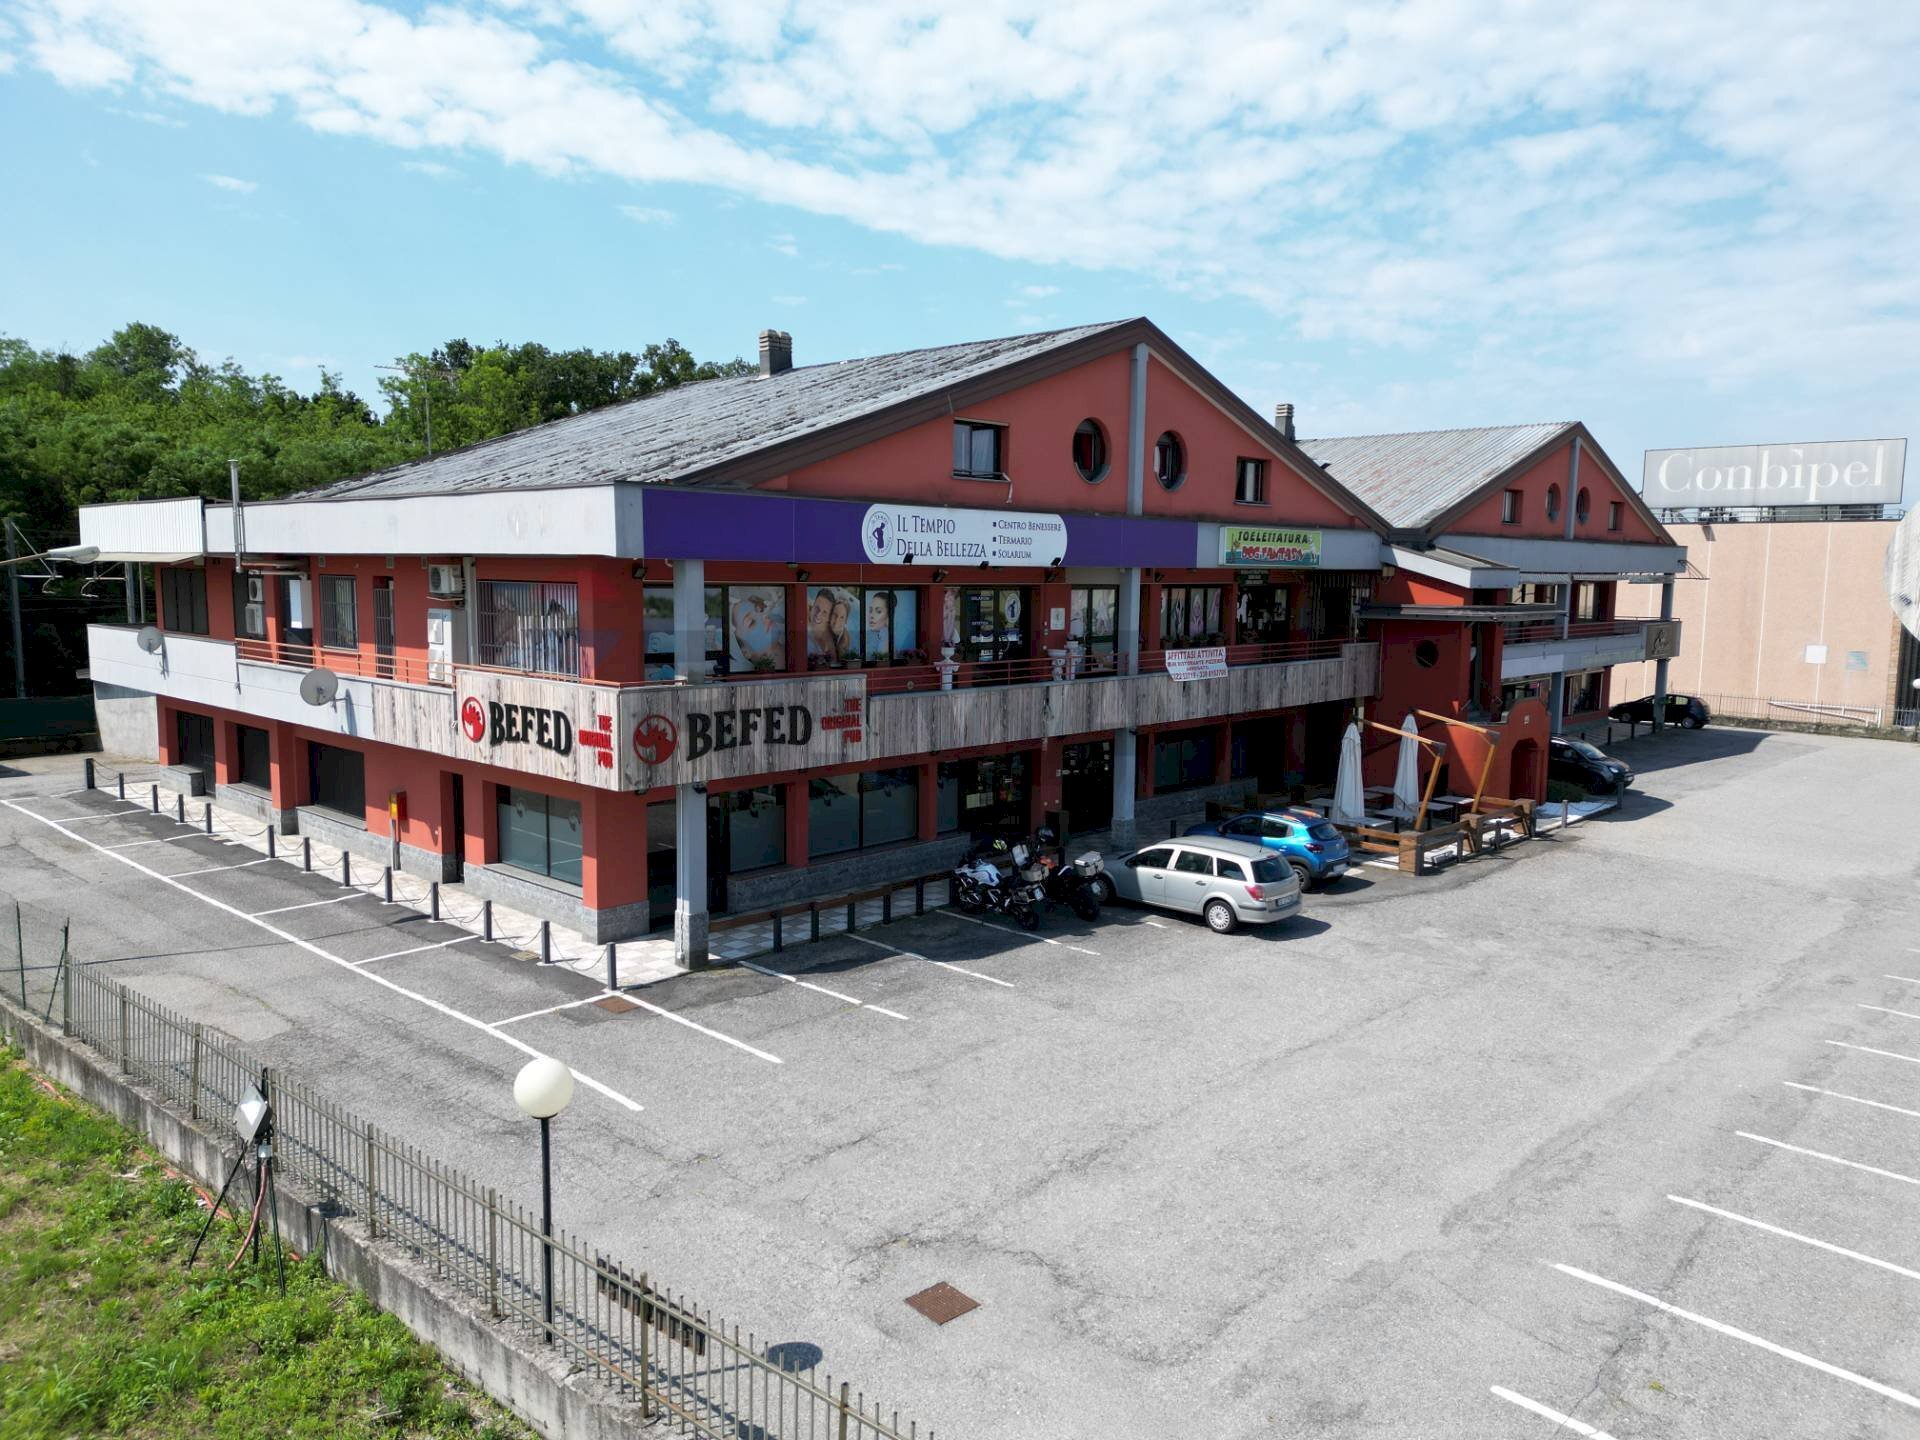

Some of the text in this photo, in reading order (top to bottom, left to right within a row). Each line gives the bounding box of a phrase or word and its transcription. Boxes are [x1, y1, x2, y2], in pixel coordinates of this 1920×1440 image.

[897, 514, 956, 534] IL TEMPIO
[998, 520, 1061, 532] CENTRO BENESSERE
[998, 535, 1032, 545] TERMARIO
[1238, 531, 1308, 544] TOELETTATURA
[897, 539, 932, 557] DELLA
[937, 540, 986, 558] BELLEZZA
[998, 549, 1031, 559] SOLARIUM
[843, 697, 862, 712] THE
[488, 701, 573, 757] BEFED
[597, 714, 613, 732] THE
[820, 714, 862, 730] ORIGINAL
[579, 729, 613, 750] ORIGINAL
[686, 705, 813, 761] BEFED
[842, 730, 862, 744] PUB
[598, 750, 613, 769] PUB
